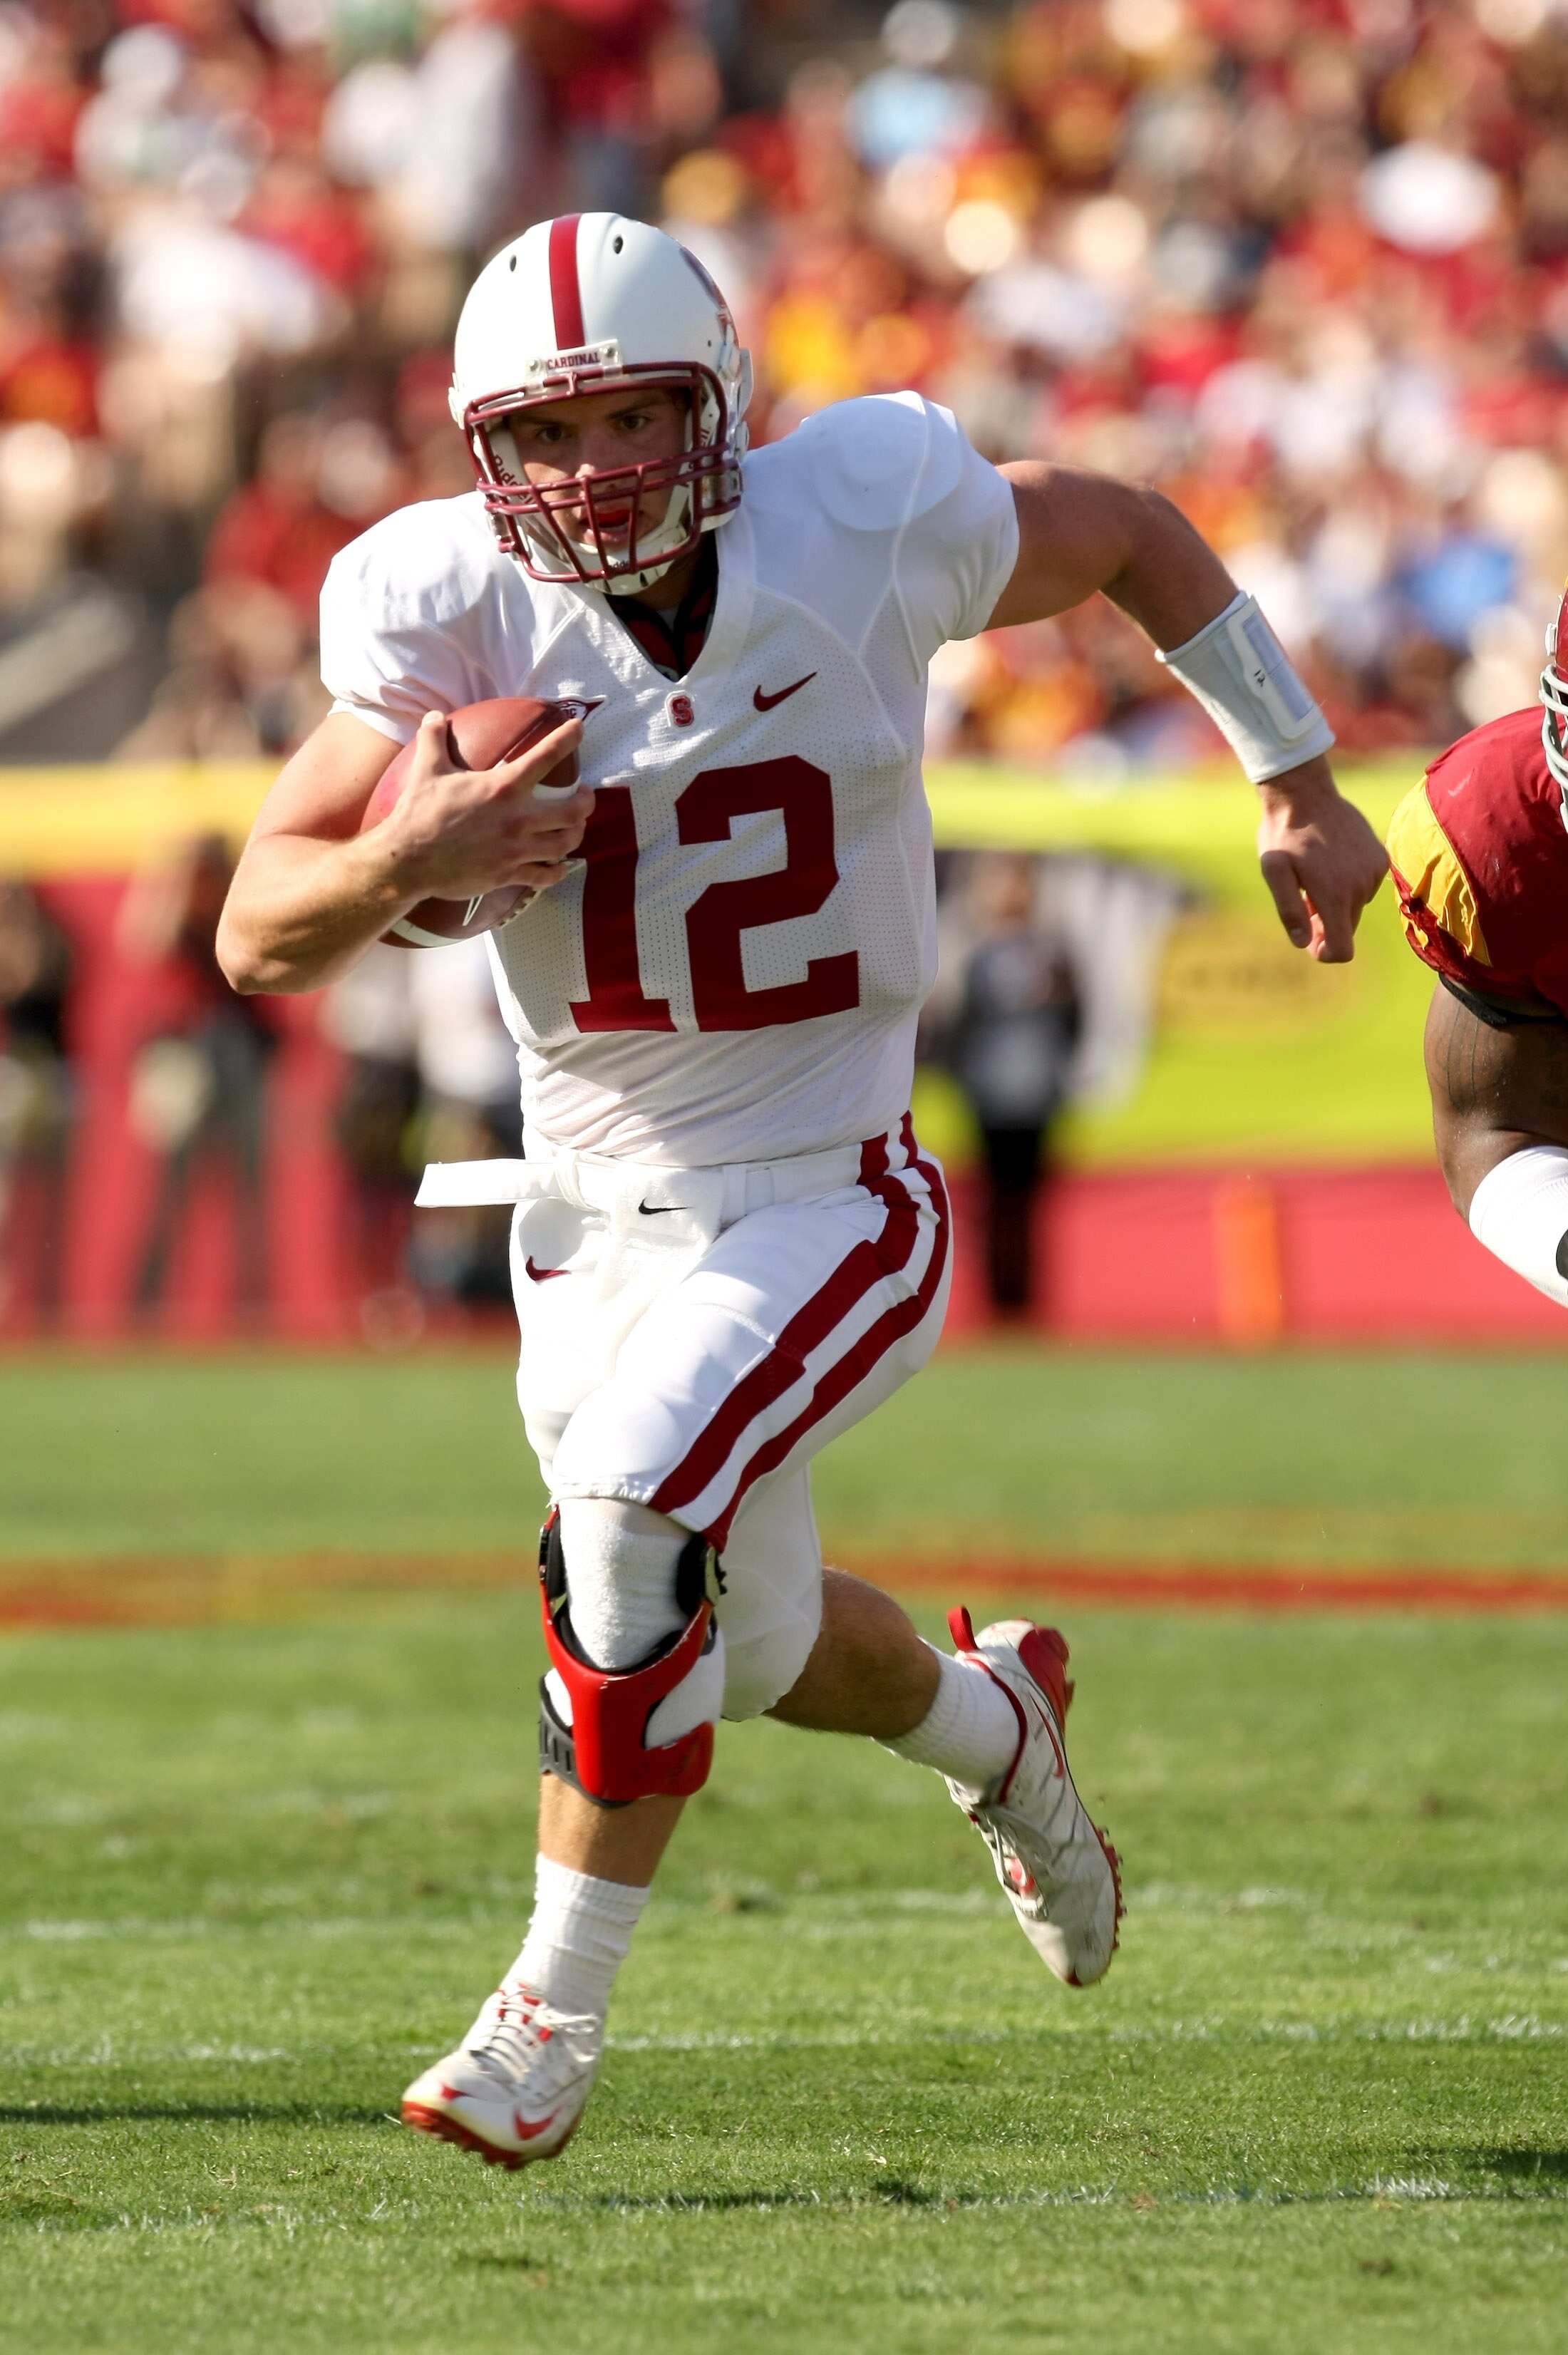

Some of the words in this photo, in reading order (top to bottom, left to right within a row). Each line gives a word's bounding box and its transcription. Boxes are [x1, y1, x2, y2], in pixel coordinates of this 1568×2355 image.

[547, 351, 601, 370] CARDINAL
[670, 695, 694, 727] S
[567, 755, 860, 1033] 12
